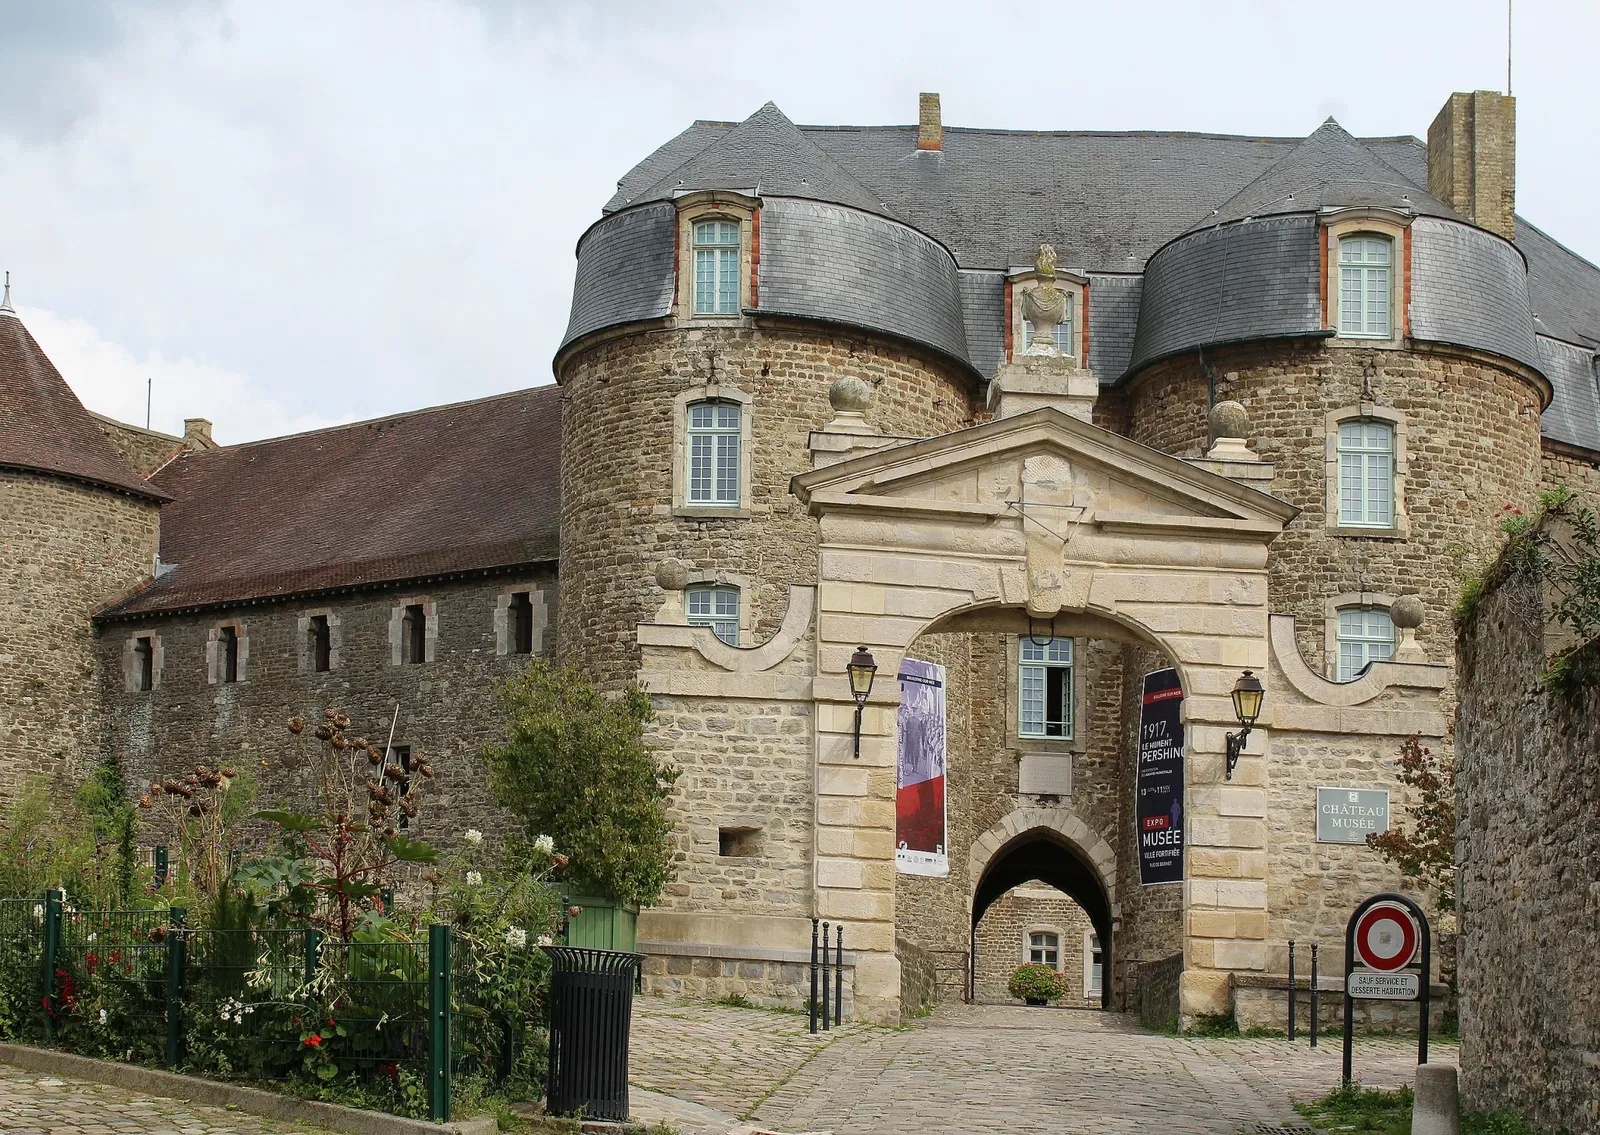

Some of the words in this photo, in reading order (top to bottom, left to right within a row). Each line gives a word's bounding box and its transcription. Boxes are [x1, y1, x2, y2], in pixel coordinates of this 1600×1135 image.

[1142, 742, 1149, 751] LE
[1150, 738, 1172, 749] MOMENT
[1322, 803, 1385, 817] CHÂTEAU
[1147, 818, 1164, 827] EXPO
[1331, 817, 1375, 829] MUSÉE
[1143, 826, 1181, 847] MUSÉE
[1358, 976, 1374, 985] SAUF
[1375, 977, 1399, 986] SERVICE
[1400, 978, 1409, 986] ET
[1351, 986, 1380, 995] DESSERTE
[1381, 987, 1416, 996] HABITATION
